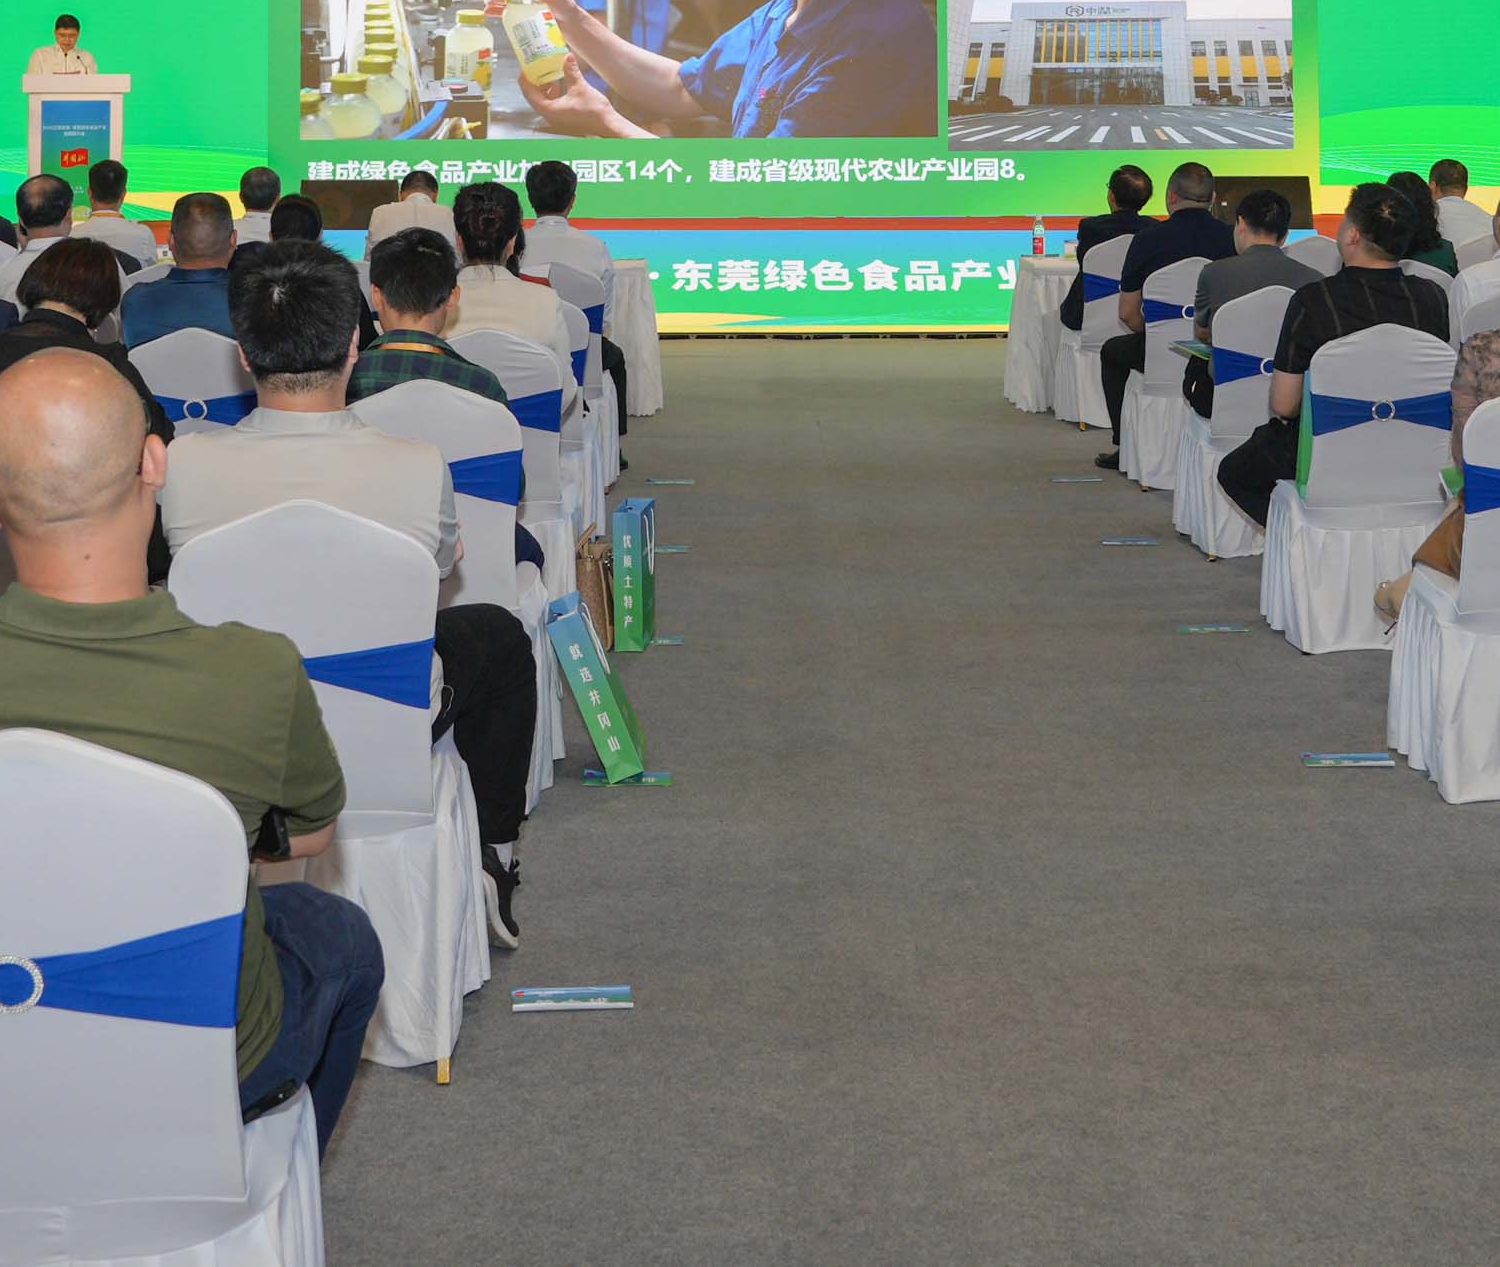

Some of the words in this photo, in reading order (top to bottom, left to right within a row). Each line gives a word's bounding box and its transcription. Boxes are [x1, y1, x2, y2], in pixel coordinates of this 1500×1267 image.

[623, 534, 634, 628] 优质土特产
[568, 643, 621, 752] 就选井冈山
